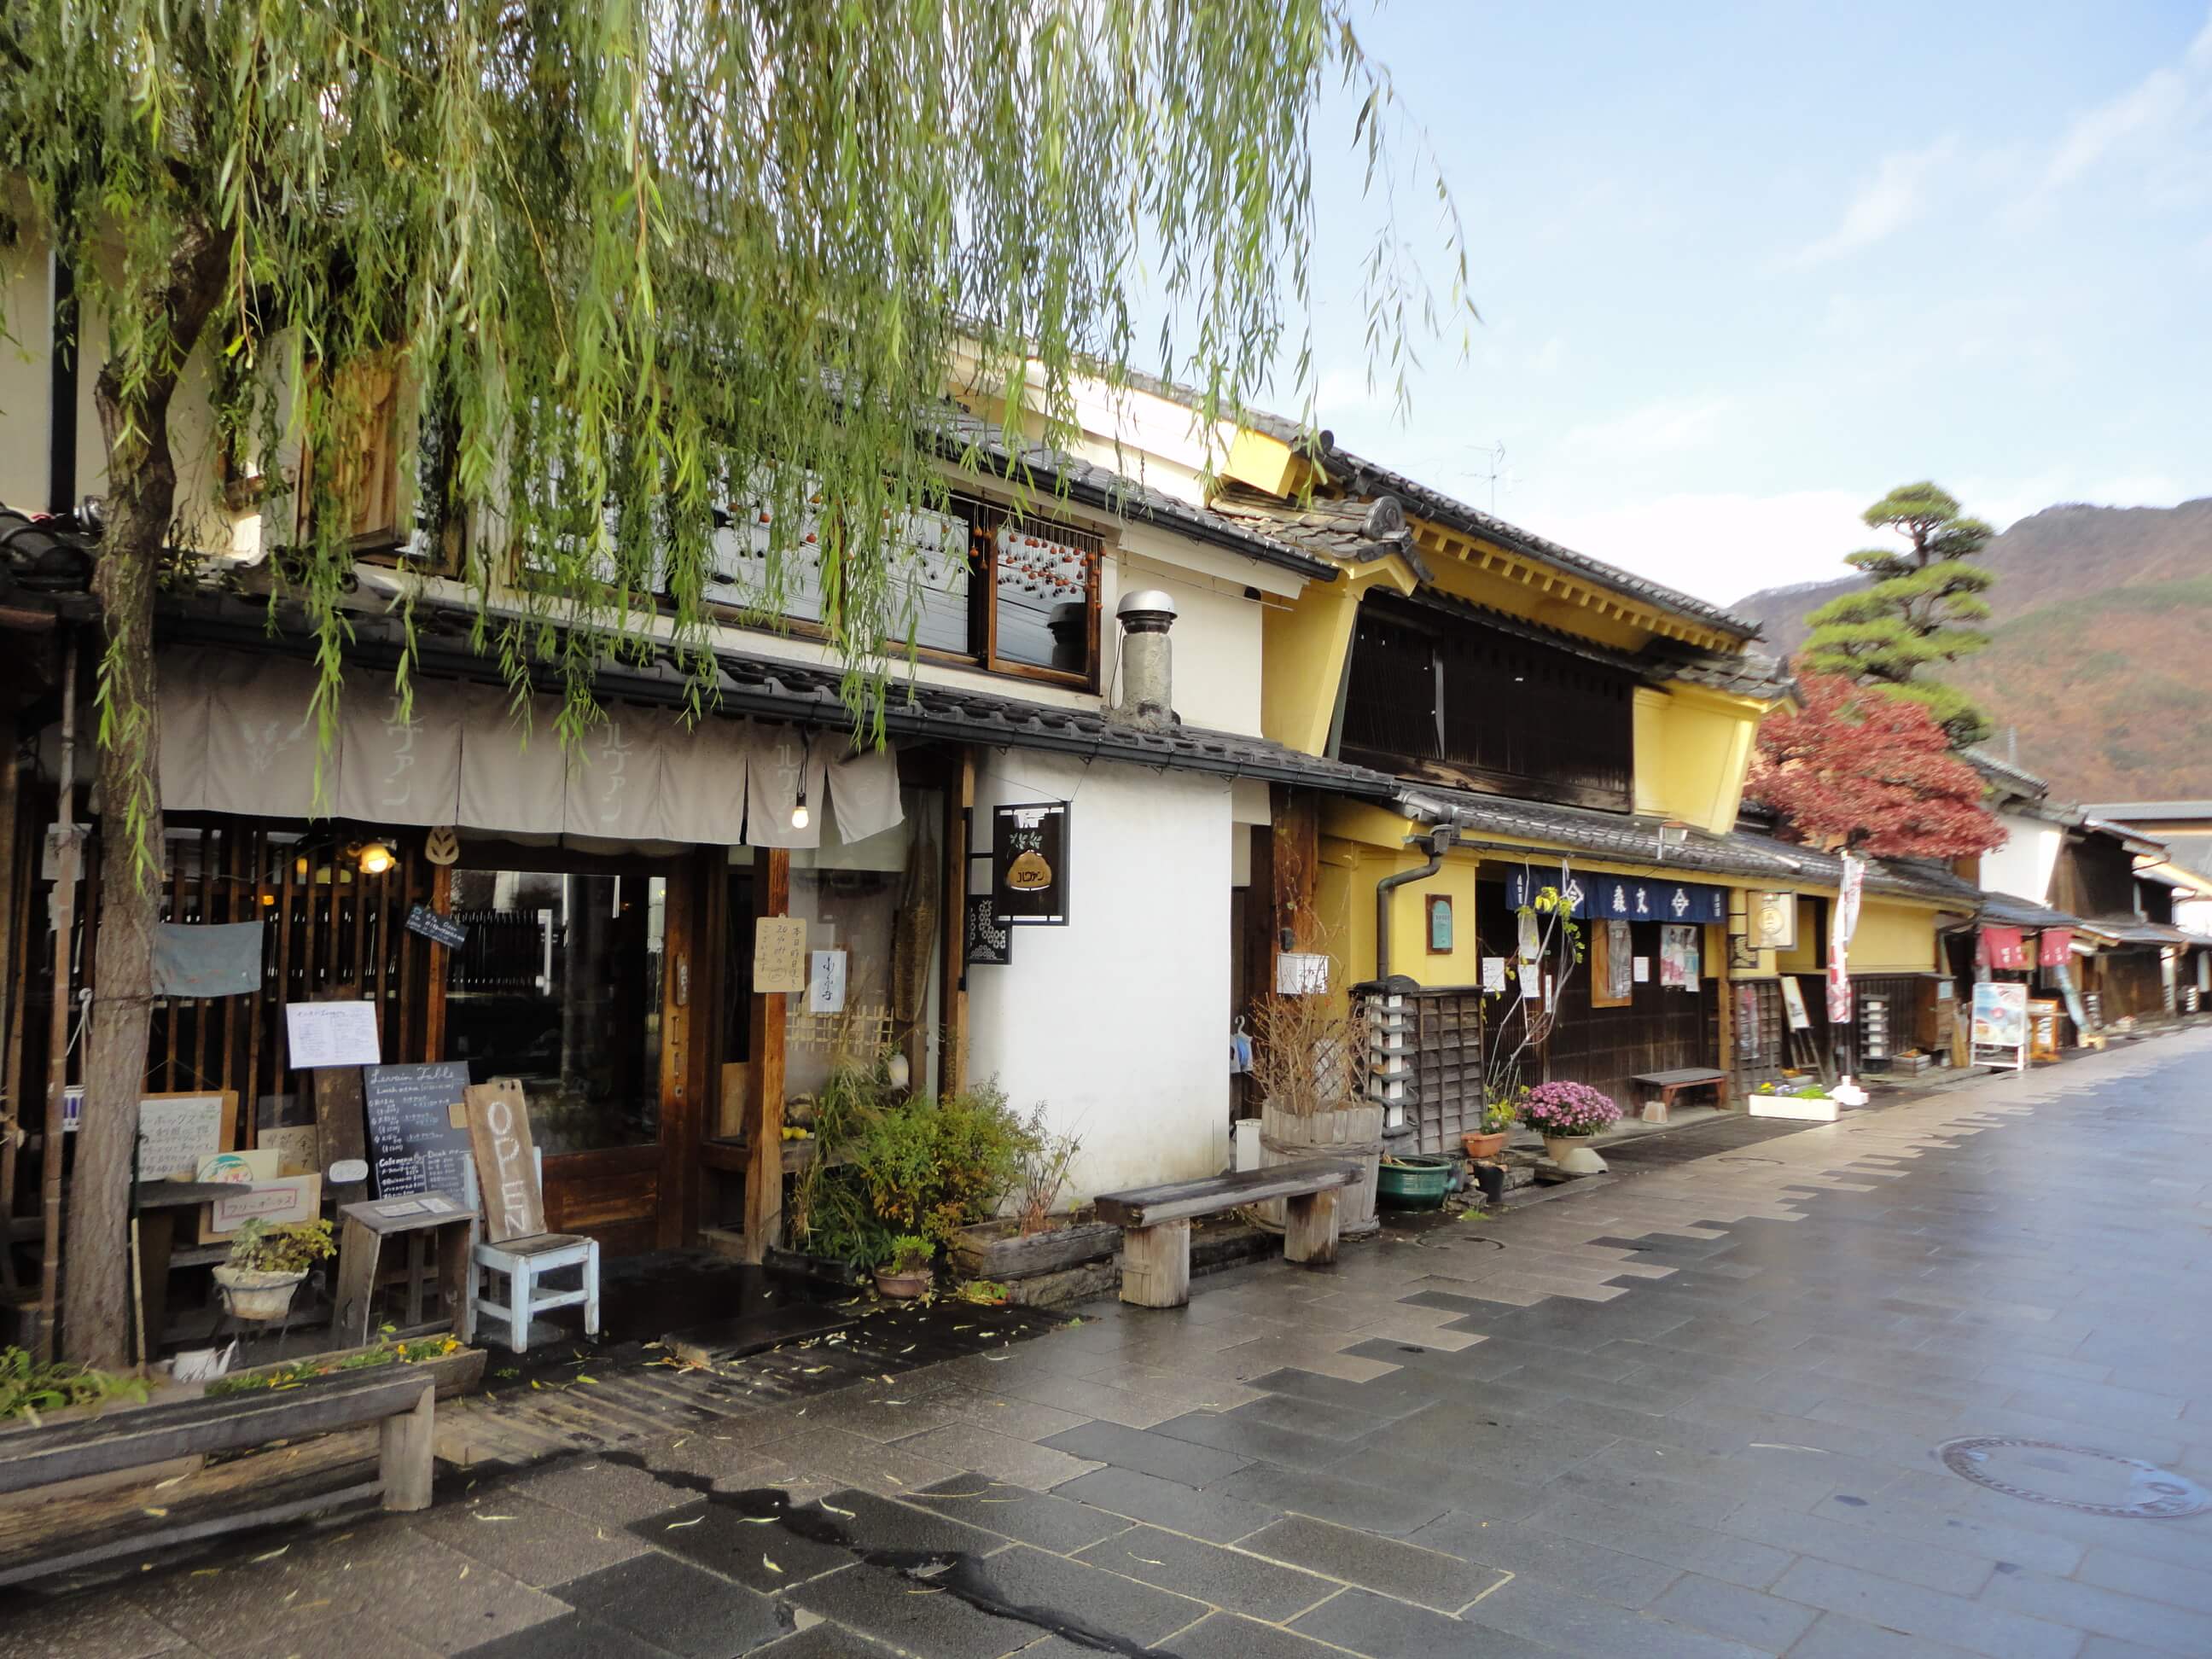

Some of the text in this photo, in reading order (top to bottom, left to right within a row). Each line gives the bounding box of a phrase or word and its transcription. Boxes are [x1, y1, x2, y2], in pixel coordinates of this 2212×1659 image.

[599, 723, 636, 821] ルヴァン
[1016, 870, 1045, 883] ルヴァン
[487, 1101, 527, 1237] OPEN
